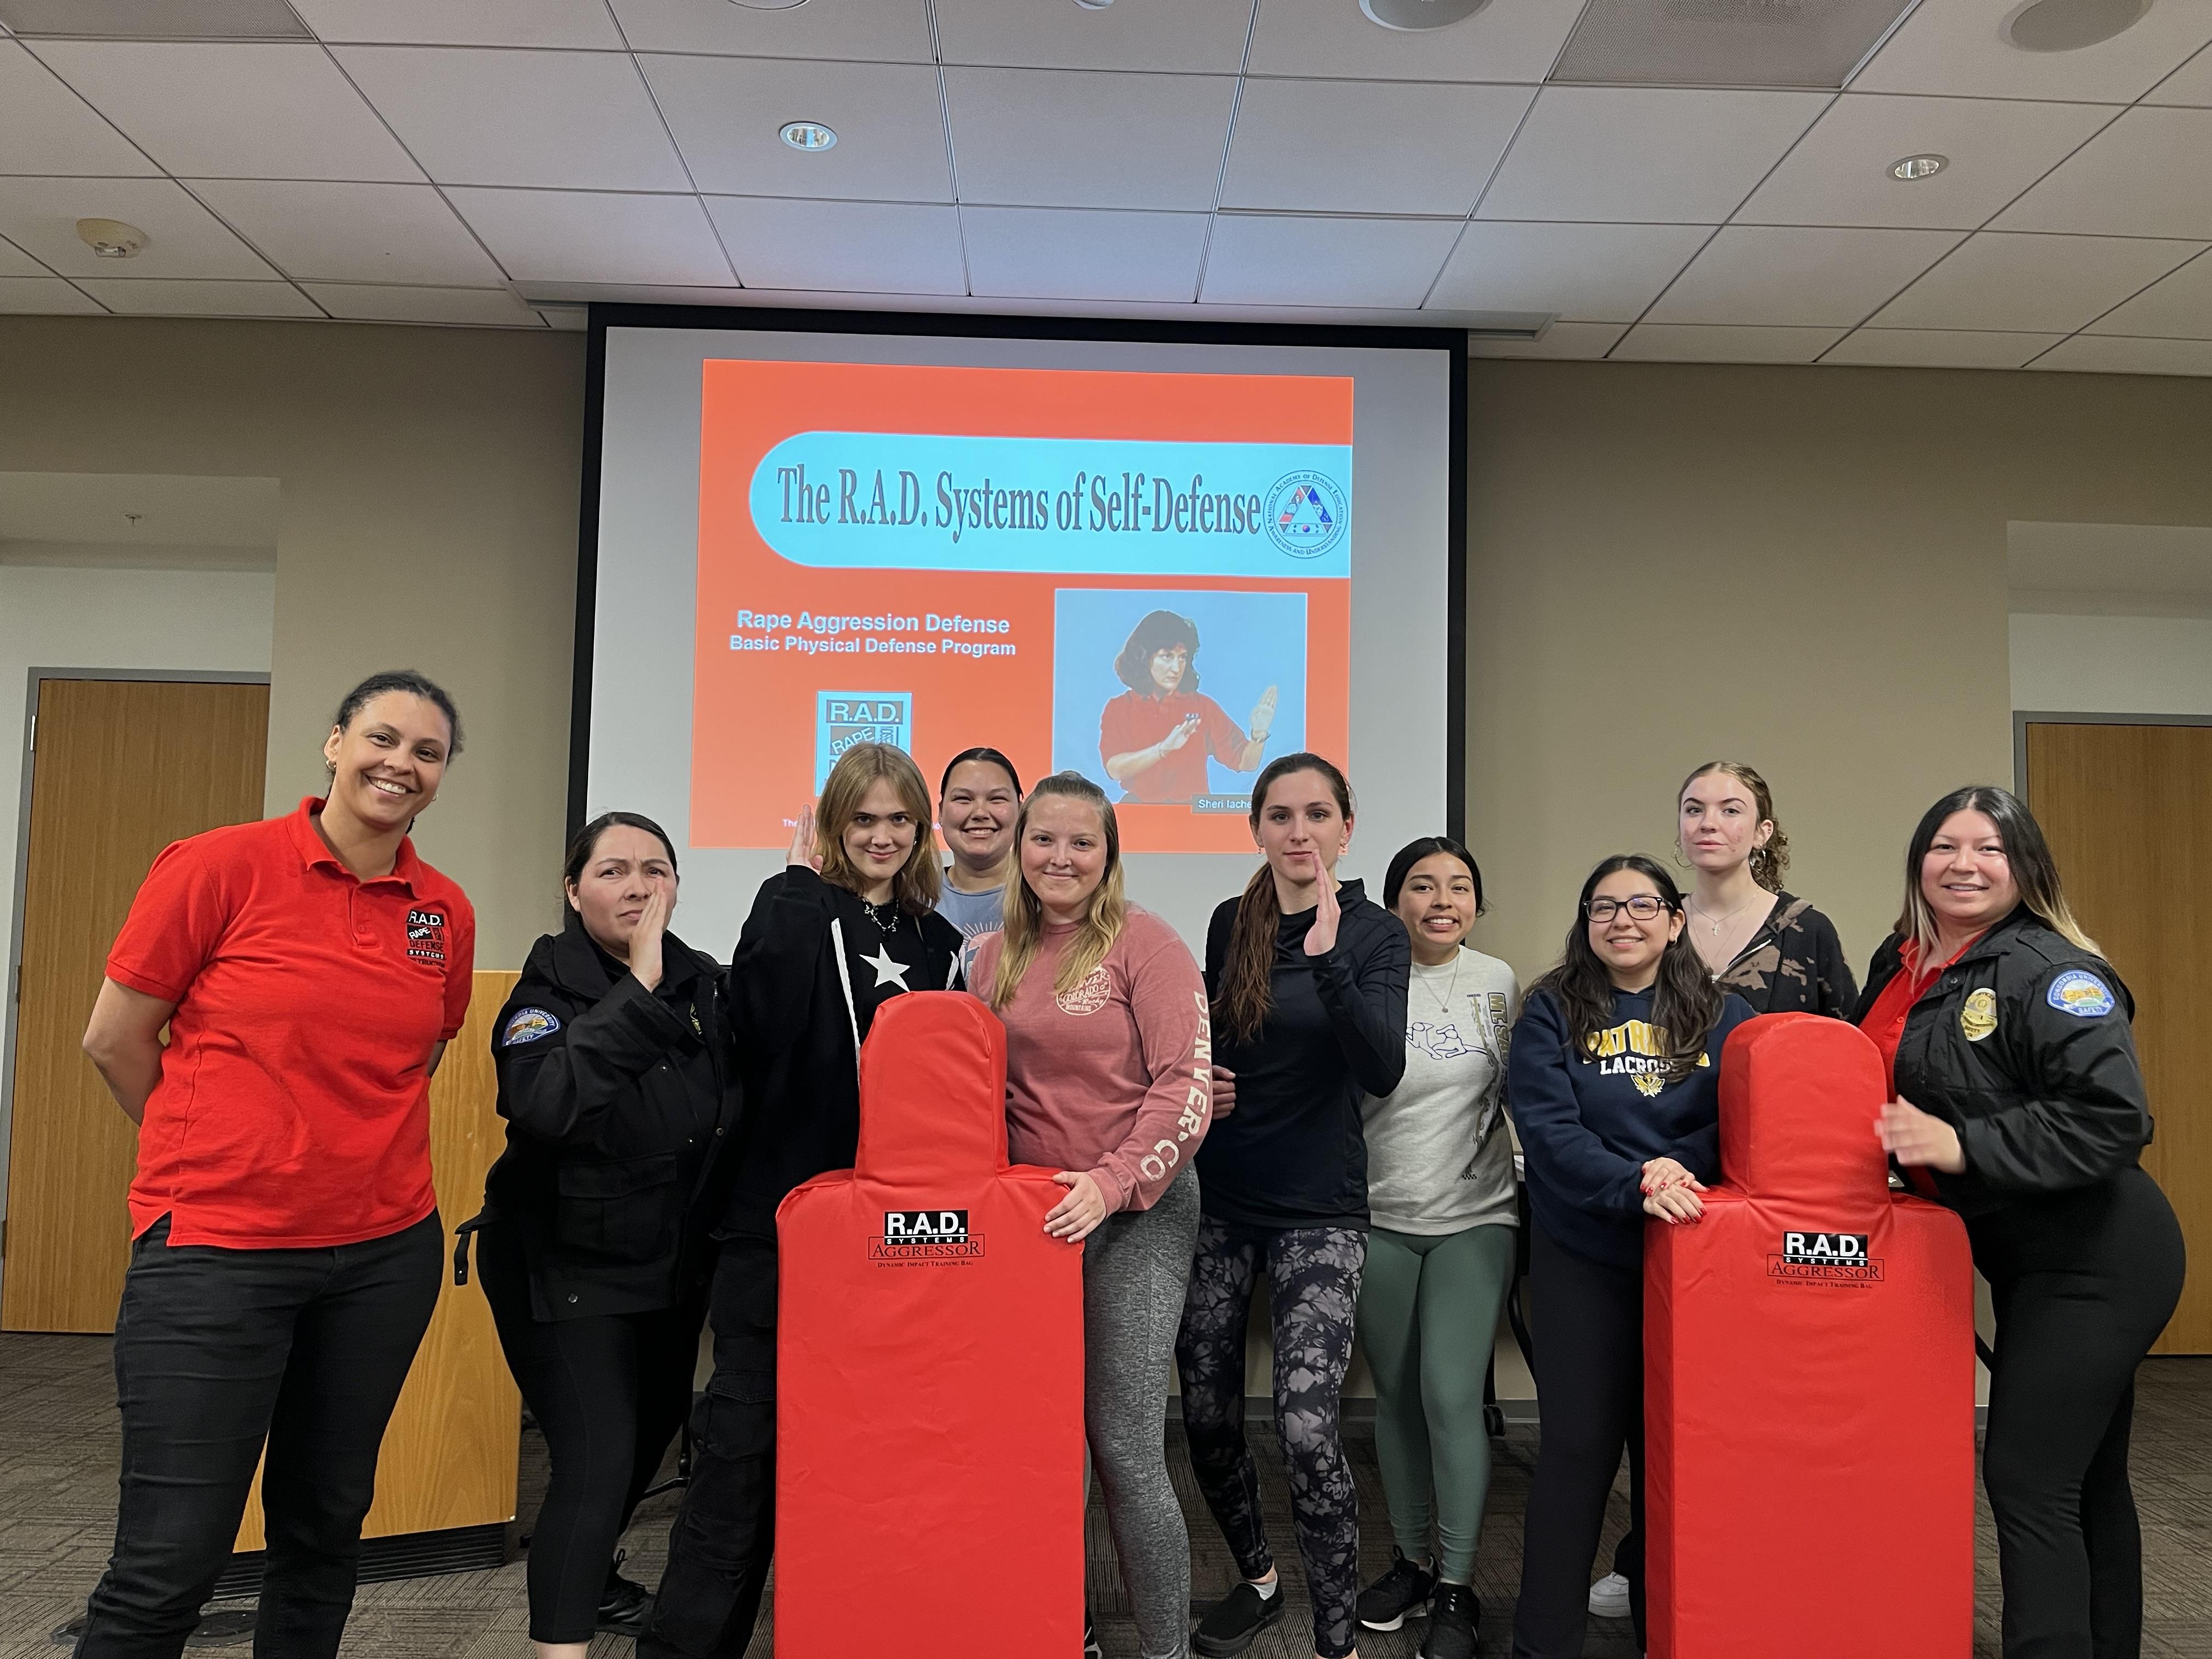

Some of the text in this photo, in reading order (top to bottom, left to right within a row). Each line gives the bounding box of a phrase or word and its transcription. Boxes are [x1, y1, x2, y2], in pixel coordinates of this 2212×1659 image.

[1276, 475, 1301, 491] ACADEMY
[778, 464, 1261, 543] The R.A.D. Systems of Self-Defense
[737, 610, 1010, 634] Rape Aggression Defense
[730, 635, 1016, 658] Basic Physical Defense Program
[831, 702, 899, 723] R.A.D.
[832, 727, 875, 754] RAPE
[1198, 799, 1251, 808] Sheri Iache
[409, 911, 442, 926] R.A.D.
[409, 927, 431, 939] RAPE
[409, 940, 444, 952] DEFENSE
[409, 950, 443, 959] SYSTEMS
[1063, 984, 1099, 1003] COLORADO
[2053, 974, 2078, 1000] CONCORDIA
[1600, 1056, 1674, 1075] LACROS
[888, 1212, 965, 1235] R.A.D.
[872, 1240, 981, 1257] AGGRESSOR
[1786, 1233, 1864, 1257] R.A.D.
[1771, 1261, 1880, 1279] AGGRESSOR
[1786, 1257, 1864, 1266] SYSTEMS
